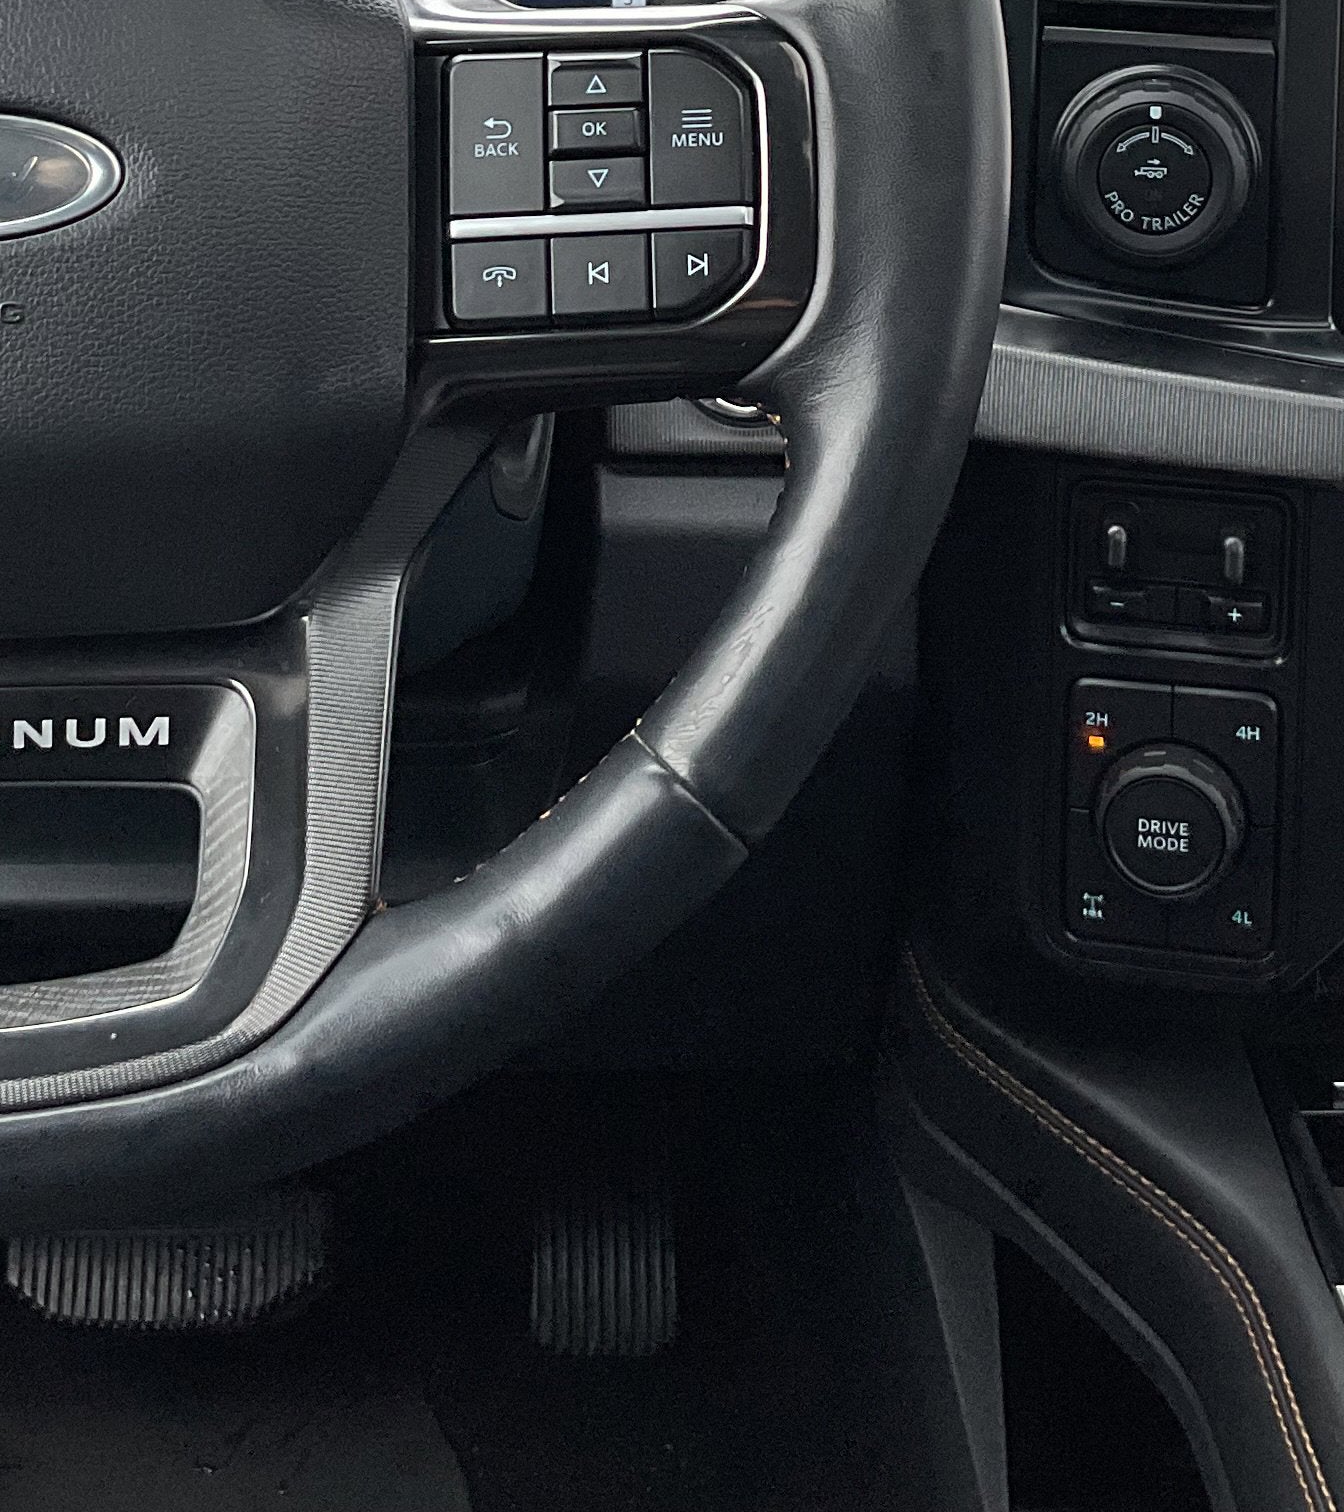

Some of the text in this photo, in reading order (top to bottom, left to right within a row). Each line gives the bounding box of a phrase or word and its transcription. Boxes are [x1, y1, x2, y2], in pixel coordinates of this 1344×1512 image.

[581, 121, 607, 136] OK
[671, 132, 724, 148] MENU
[474, 143, 519, 158] BACK
[1104, 190, 1205, 230] PRO TRAILER
[1085, 711, 1109, 727] 2H
[1235, 725, 1260, 741] 4H
[1137, 818, 1189, 835] DRIVE
[1137, 835, 1189, 852] MODE
[1231, 910, 1252, 926] 4L
